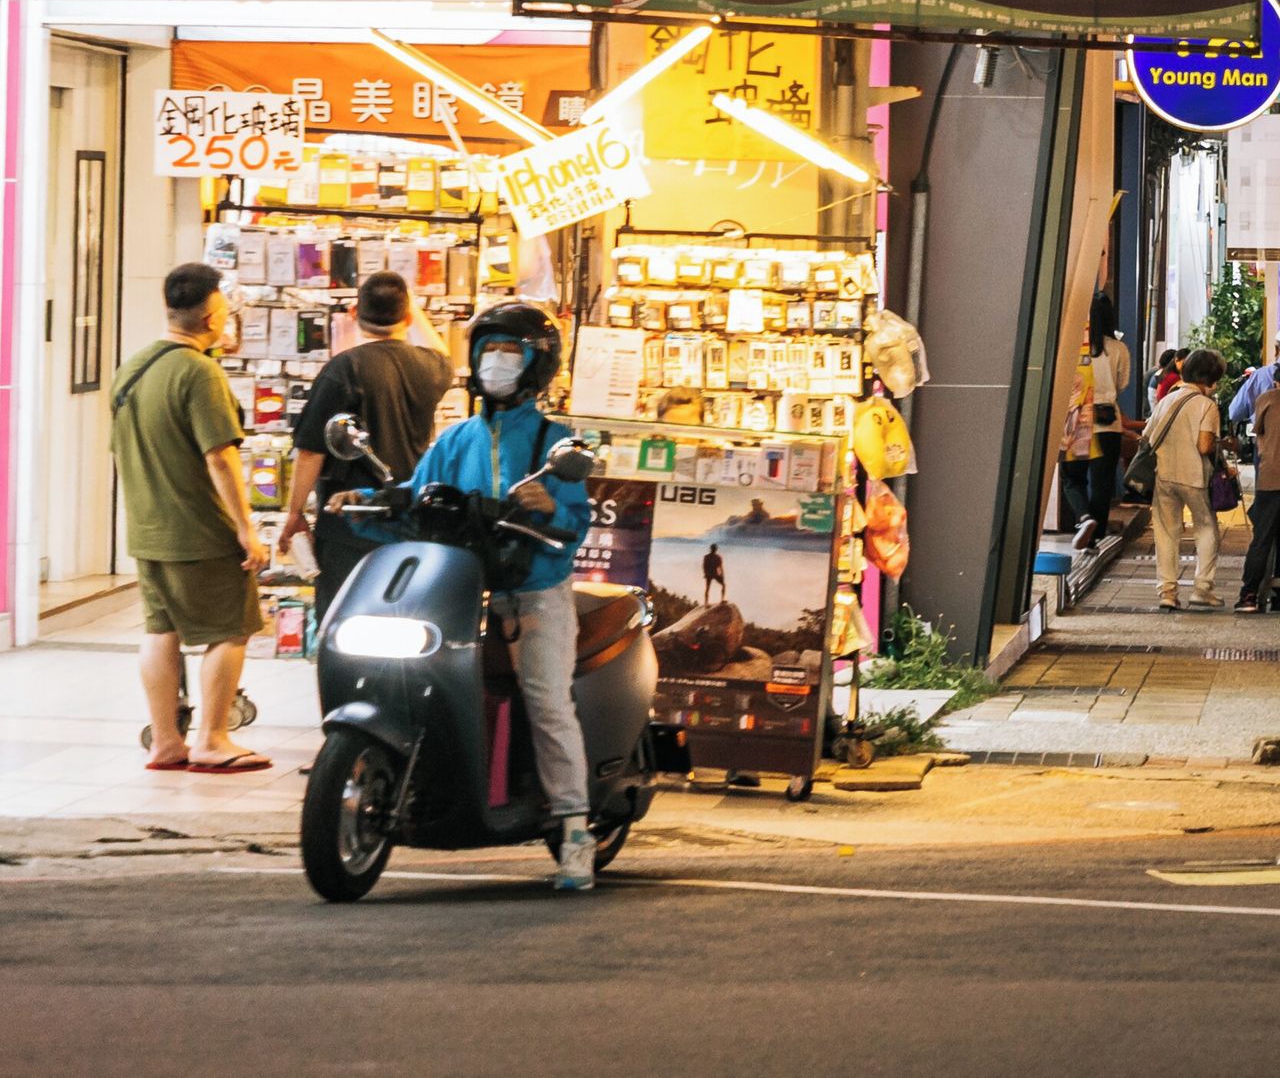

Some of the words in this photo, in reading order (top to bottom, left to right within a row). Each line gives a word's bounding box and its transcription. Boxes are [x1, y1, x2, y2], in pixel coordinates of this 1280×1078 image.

[1150, 67, 1215, 89] Young
[1222, 68, 1268, 87] Man
[166, 134, 299, 172] 250元
